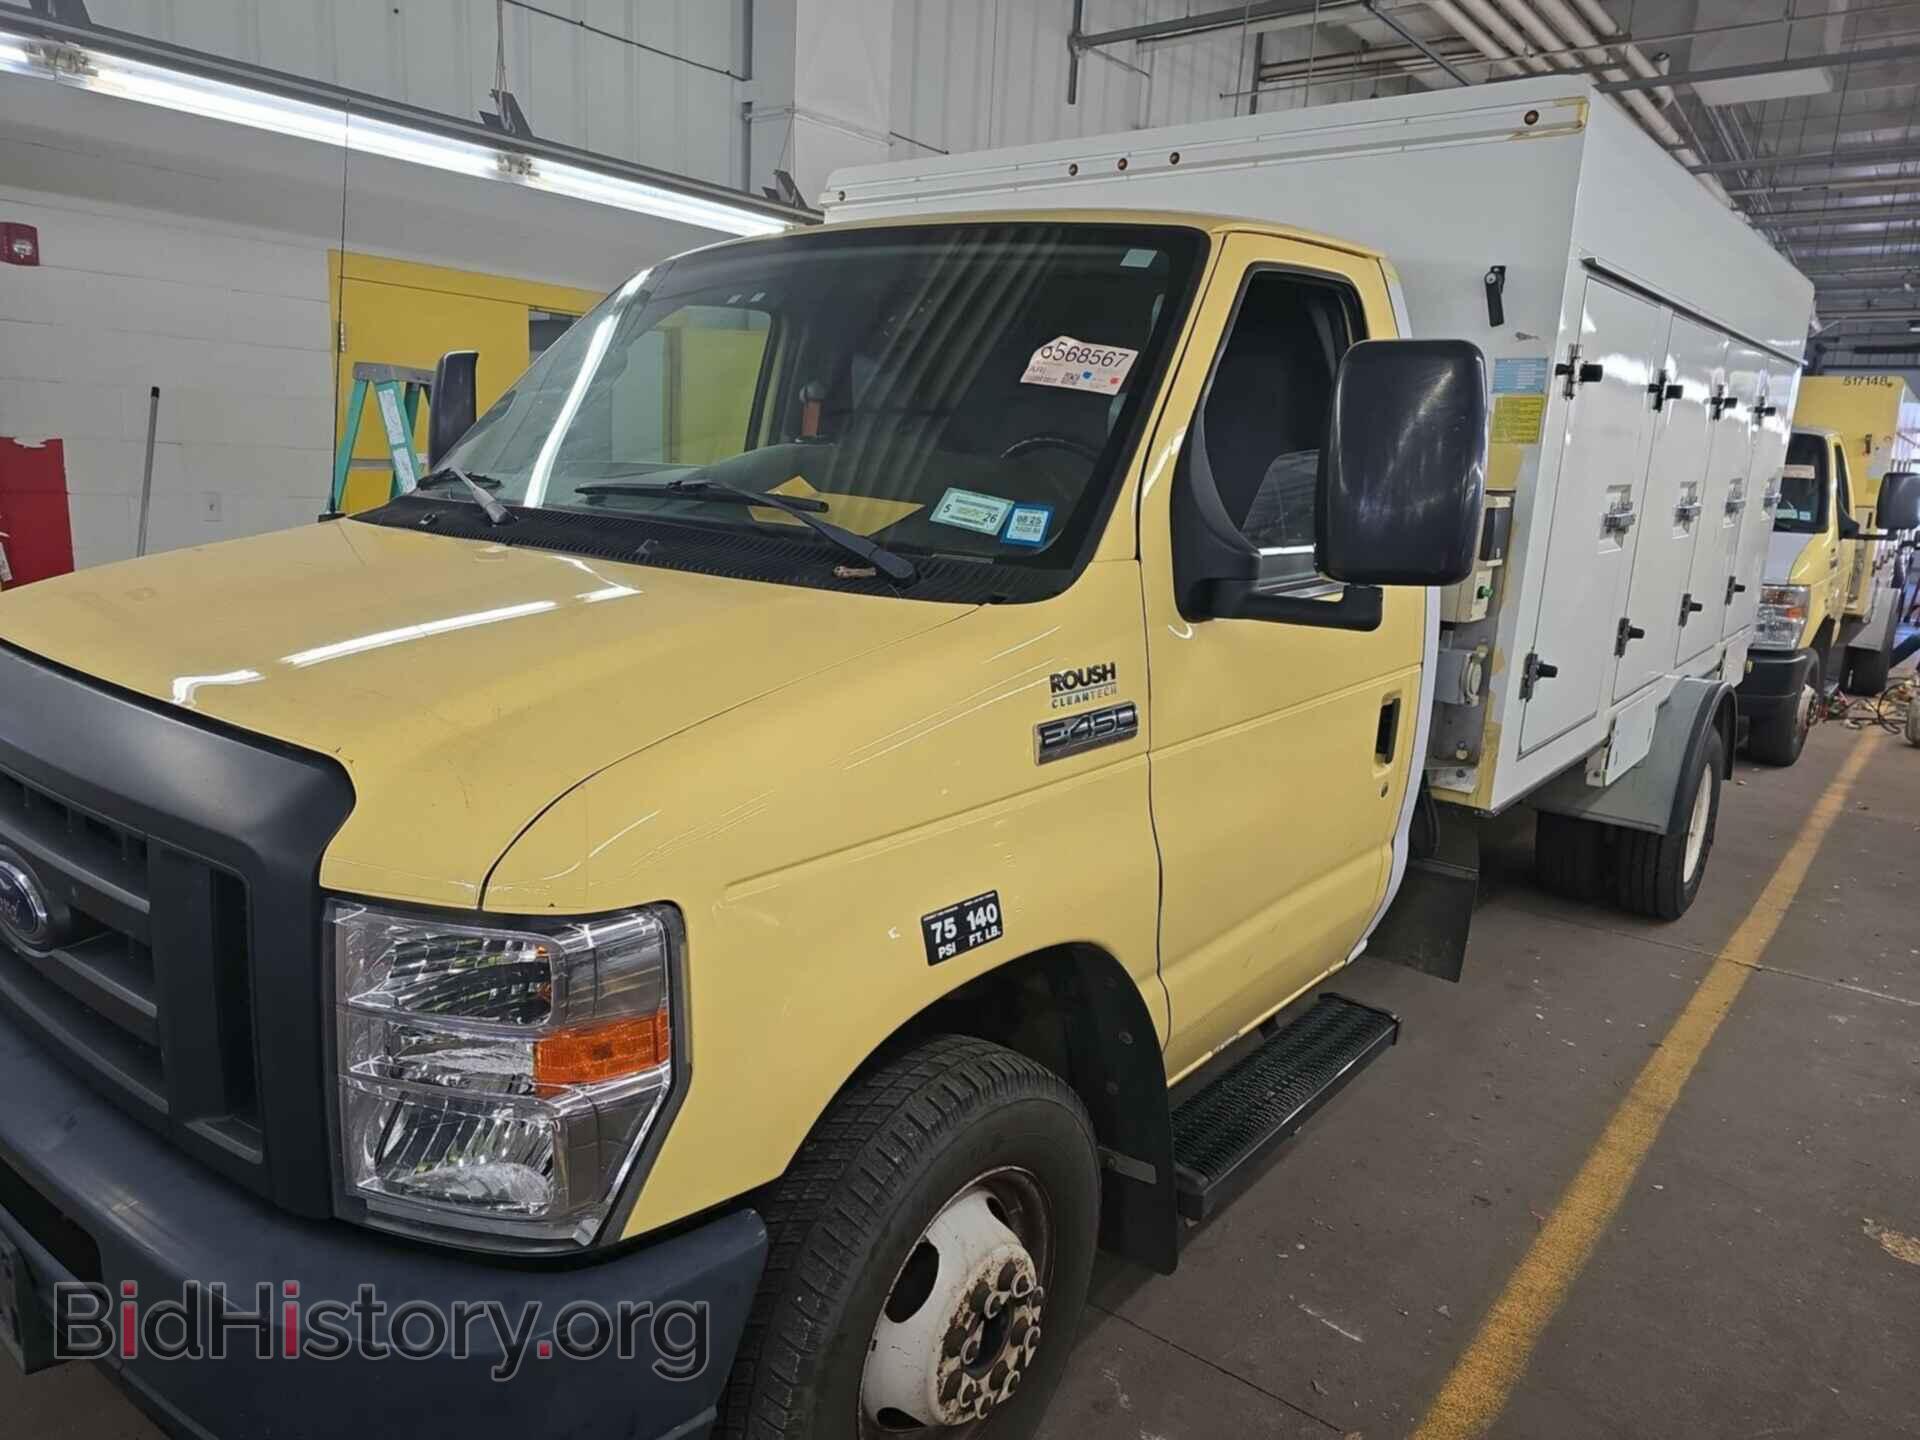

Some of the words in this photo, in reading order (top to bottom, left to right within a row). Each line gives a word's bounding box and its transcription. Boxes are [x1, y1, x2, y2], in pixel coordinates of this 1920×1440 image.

[943, 504, 951, 513] 5
[983, 512, 997, 524] 26
[1050, 662, 1116, 693] ROUSH
[1051, 687, 1117, 709] CLEANTECH
[930, 917, 957, 944] 75
[966, 903, 998, 931] 140
[937, 941, 956, 959] PSI
